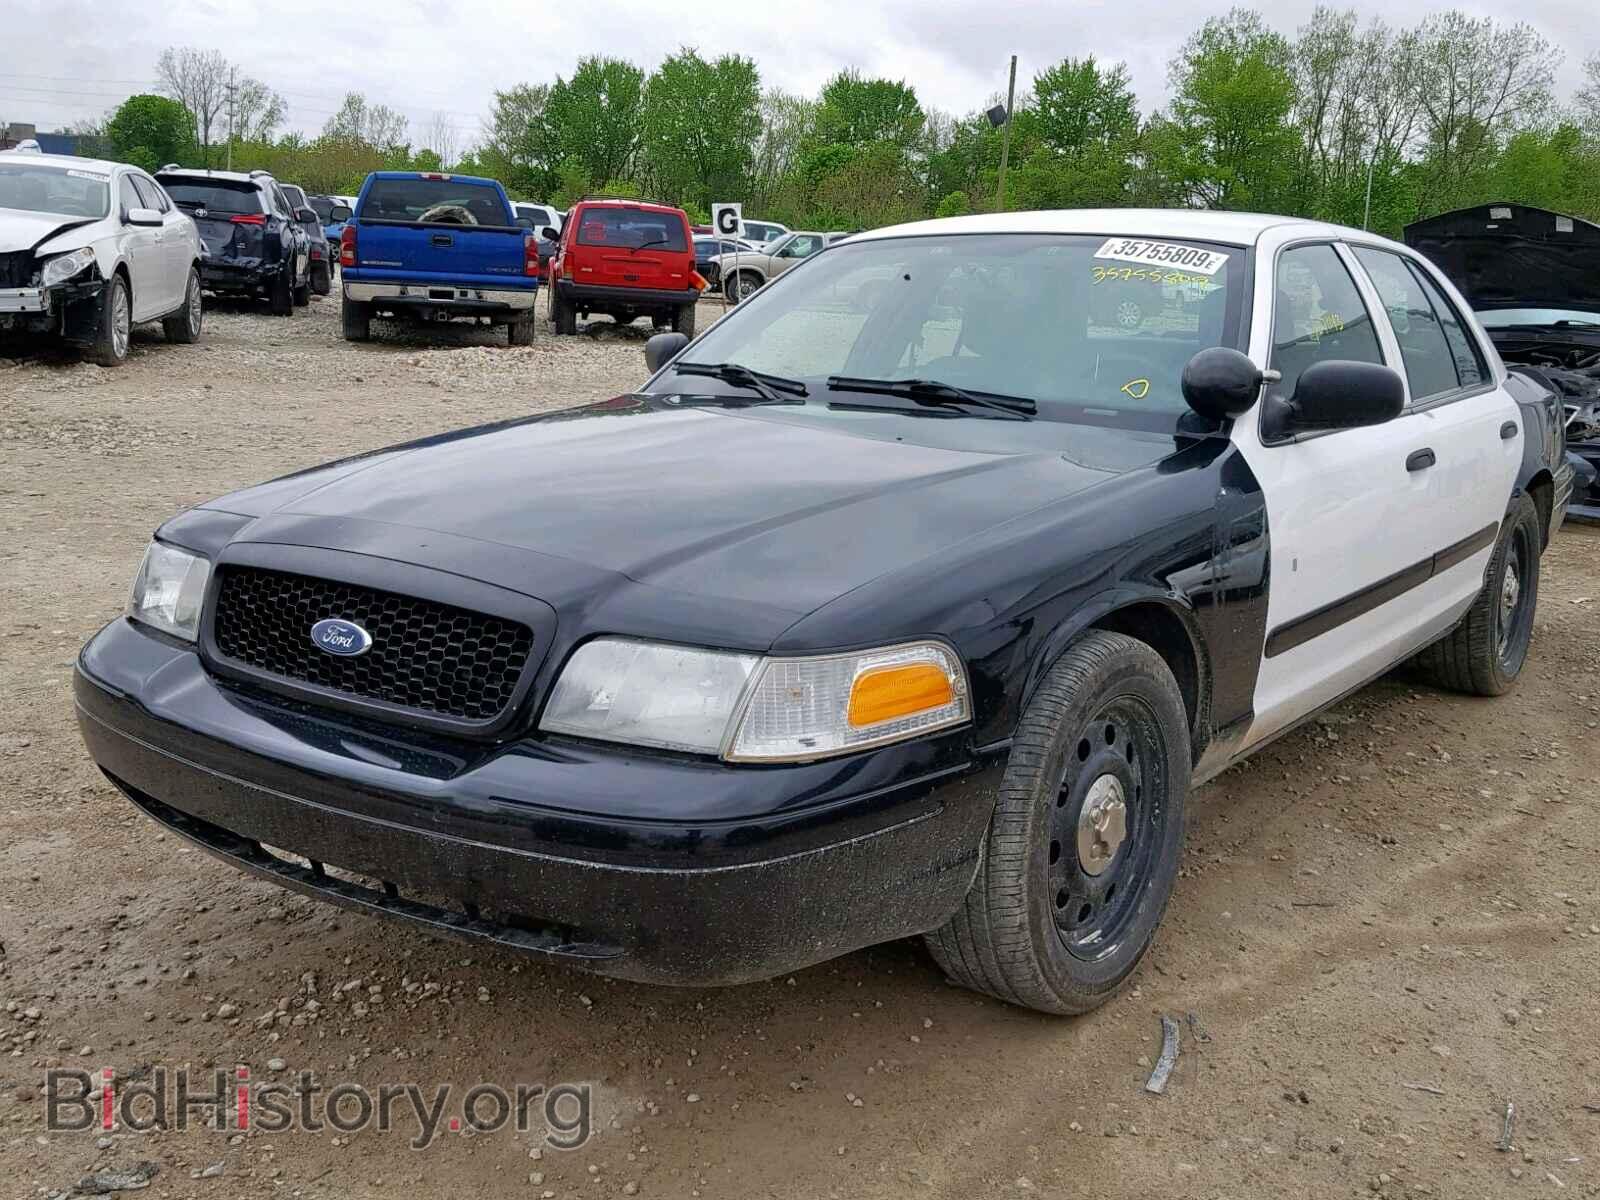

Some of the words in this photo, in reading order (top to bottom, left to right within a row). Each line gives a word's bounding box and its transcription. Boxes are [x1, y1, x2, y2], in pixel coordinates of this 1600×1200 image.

[717, 207, 738, 235] G
[1113, 240, 1210, 268] 35755809
[322, 624, 355, 648] Ford
